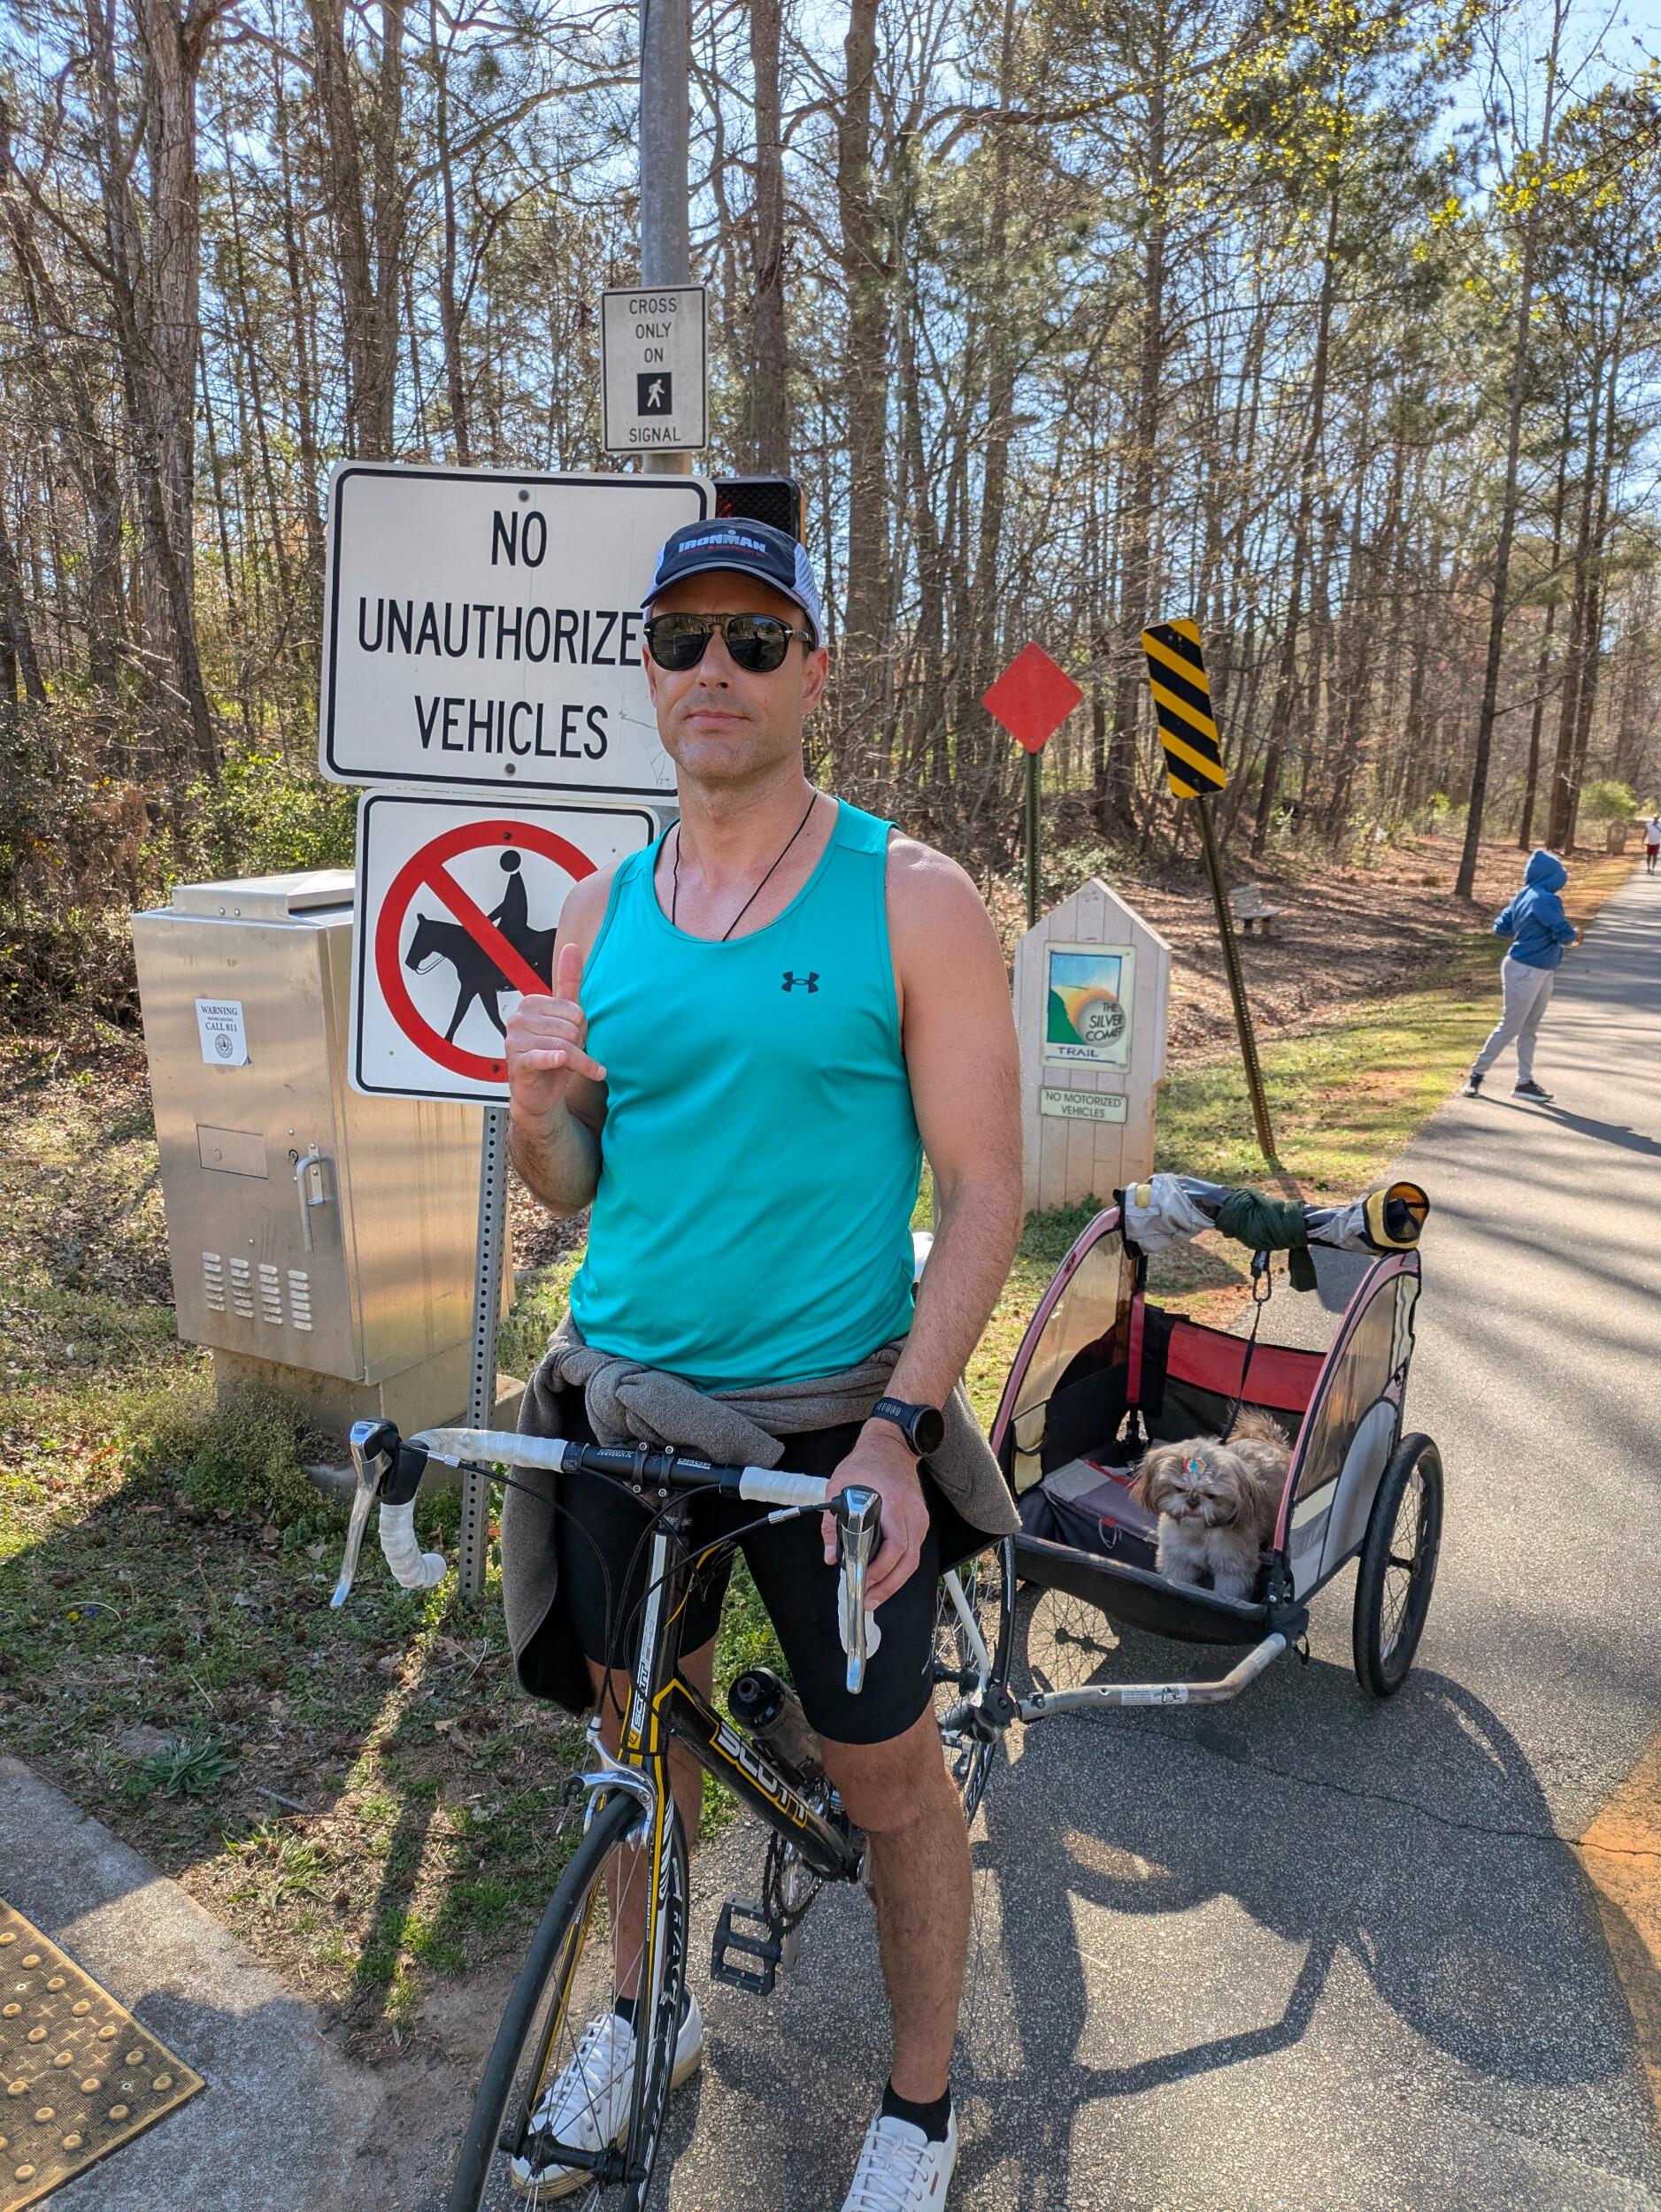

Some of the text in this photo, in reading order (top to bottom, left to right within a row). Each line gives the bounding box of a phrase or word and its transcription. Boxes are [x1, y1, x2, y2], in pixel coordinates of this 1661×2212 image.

[629, 297, 677, 314] CROSS
[635, 322, 672, 339] ONLY
[643, 348, 664, 363] ON
[629, 426, 681, 442] SIGNAL
[490, 510, 547, 568] NO
[678, 531, 766, 553] IRONMAN
[358, 597, 643, 667] UNAUTHORIZE
[414, 695, 608, 760] VEHICLES
[201, 1005, 238, 1016] WARNING
[1103, 1002, 1118, 1012] THE
[205, 1021, 237, 1032] CALL 811
[1057, 1047, 1099, 1057] TRAIL
[1046, 1092, 1121, 1108] NO MOTORIZED
[1061, 1105, 1105, 1118] VEHICLES
[633, 1663, 650, 1730] SCTT
